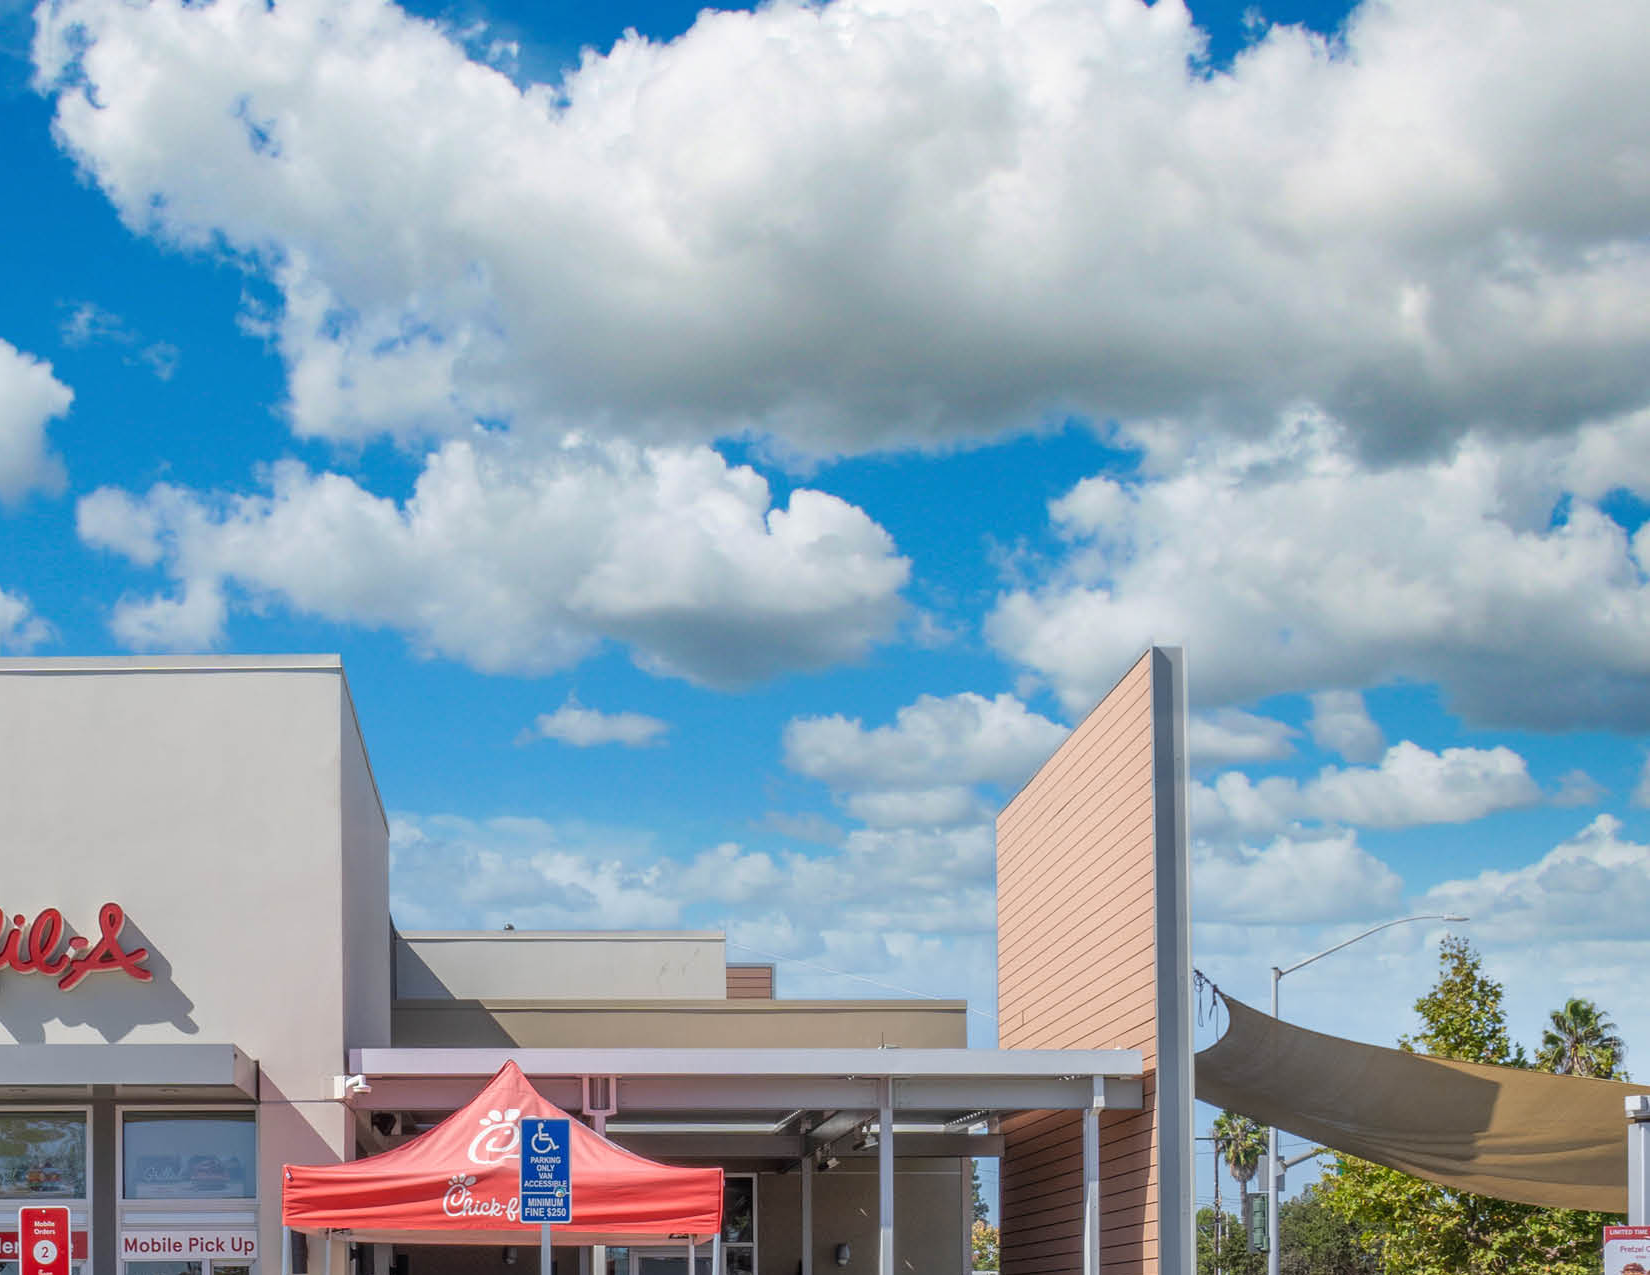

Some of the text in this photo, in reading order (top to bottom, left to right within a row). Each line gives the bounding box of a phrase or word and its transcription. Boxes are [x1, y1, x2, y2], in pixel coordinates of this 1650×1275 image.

[524, 1180, 567, 1188] ACCESSIBLE
[443, 1180, 520, 1221] Chick-f
[528, 1198, 564, 1207] MINIMUM
[525, 1207, 567, 1217] FINE $250
[124, 1236, 255, 1256] Mobile Pick Up
[41, 1246, 49, 1258] 2
